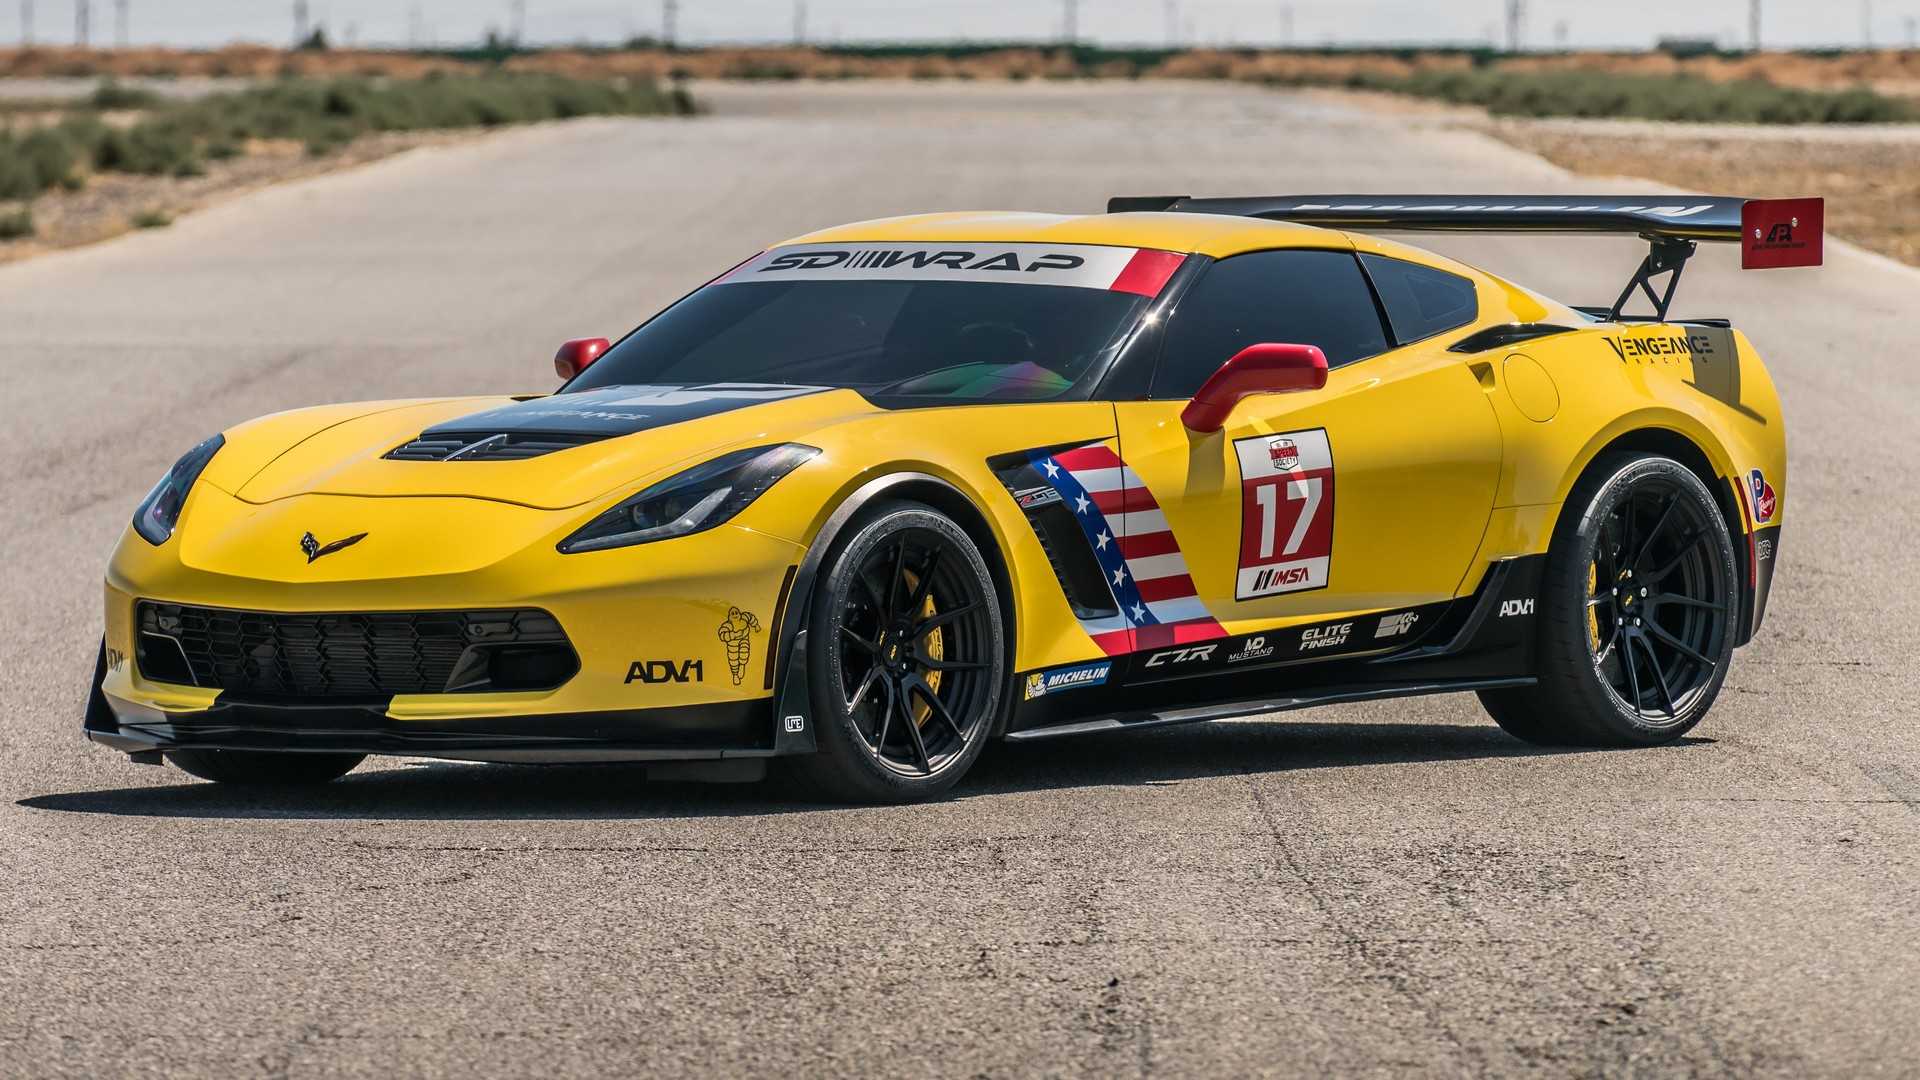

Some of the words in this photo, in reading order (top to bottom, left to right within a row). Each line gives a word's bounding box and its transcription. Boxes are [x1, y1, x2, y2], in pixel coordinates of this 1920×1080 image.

[1601, 336, 1714, 364] VENGEANCE
[1256, 477, 1323, 559] 17
[1271, 567, 1309, 587] IMSA
[1301, 622, 1354, 641] ELITE
[1299, 635, 1347, 651] FINISH
[1228, 646, 1274, 660] MUSTANG
[1048, 667, 1110, 686] MICHELIN
